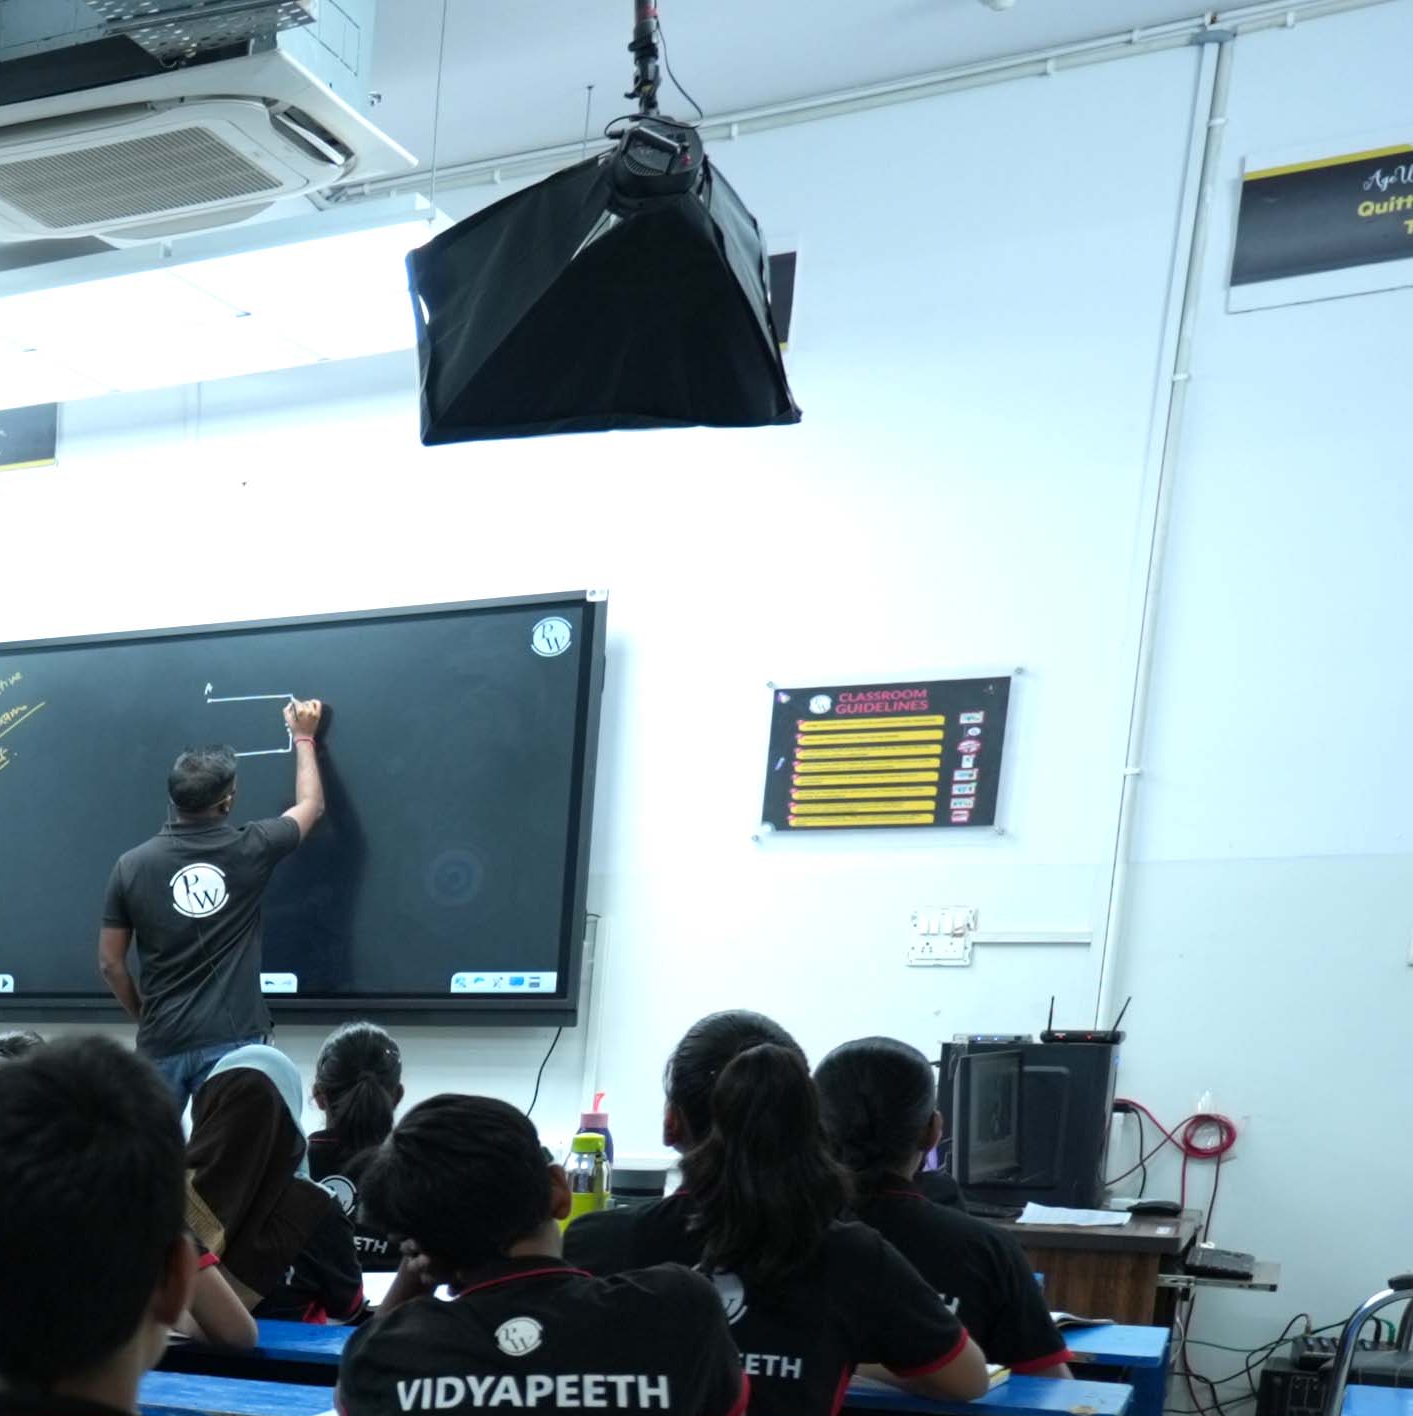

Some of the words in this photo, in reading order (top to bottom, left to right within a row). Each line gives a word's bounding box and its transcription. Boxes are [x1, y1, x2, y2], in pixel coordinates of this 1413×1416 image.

[835, 700, 928, 715] GUIDELINES
[839, 689, 927, 703] CLASSROOM
[177, 867, 227, 914] PW
[396, 1373, 671, 1413] VIDYAPEETH
